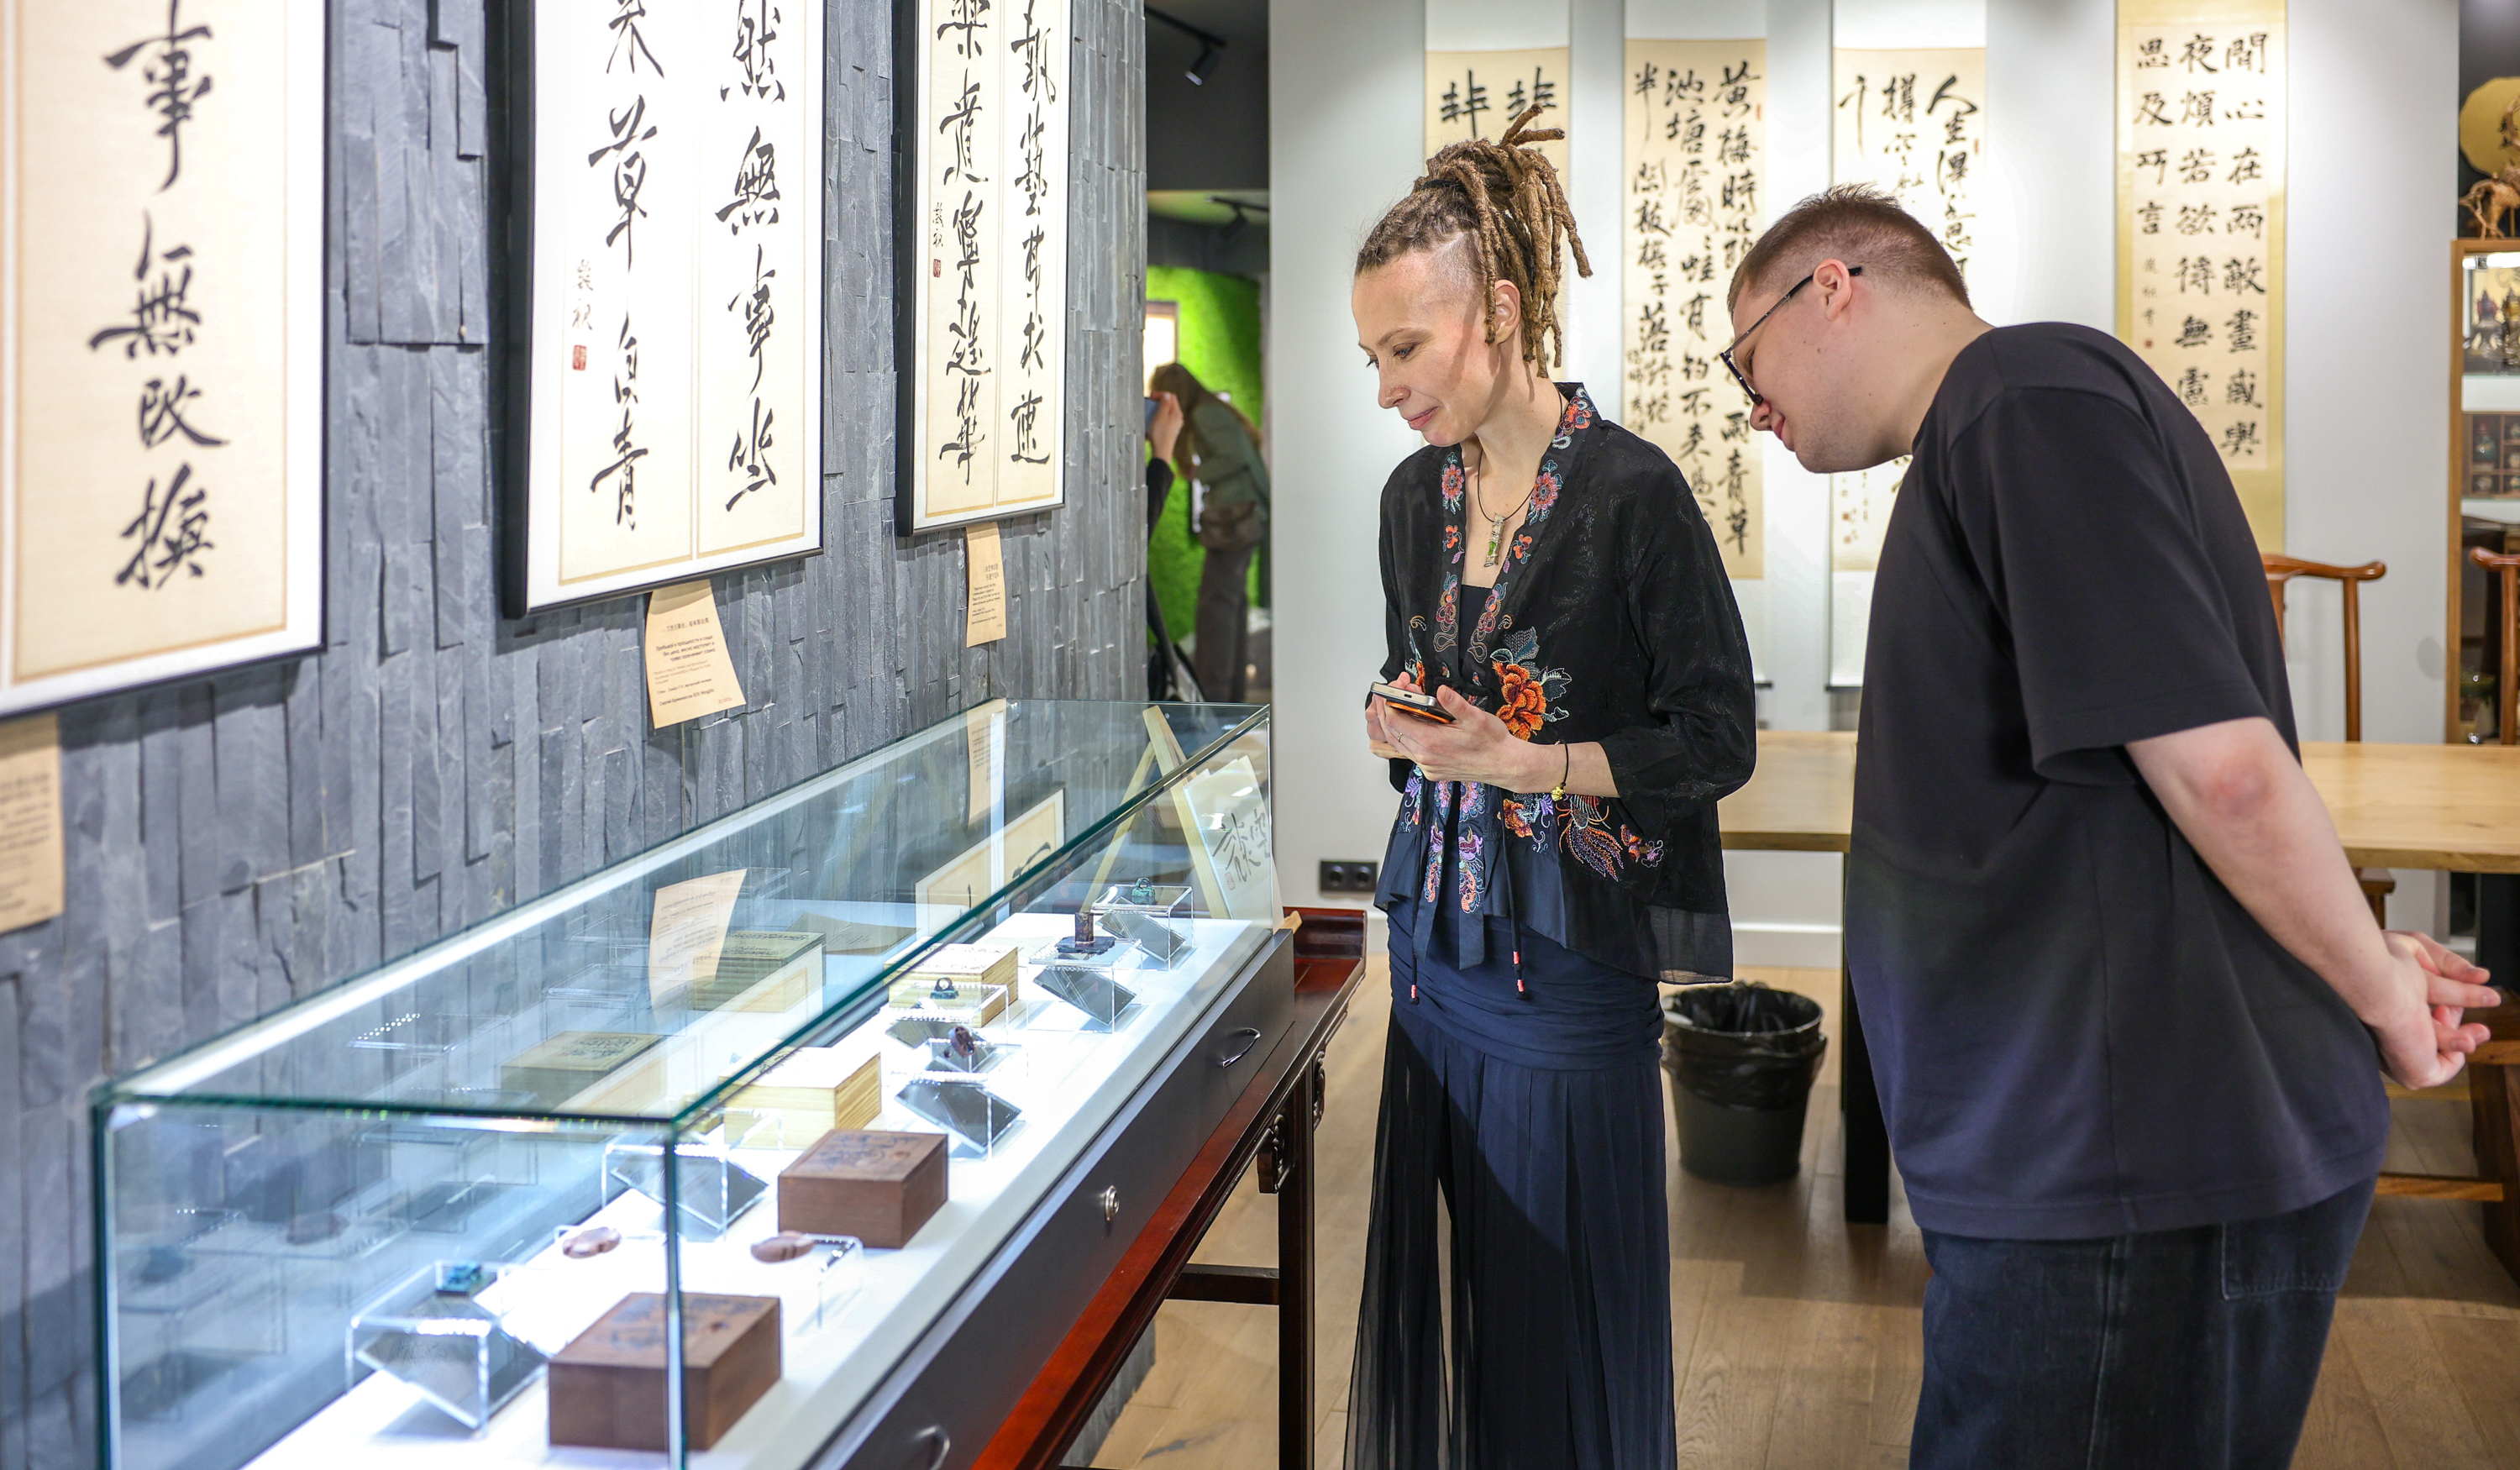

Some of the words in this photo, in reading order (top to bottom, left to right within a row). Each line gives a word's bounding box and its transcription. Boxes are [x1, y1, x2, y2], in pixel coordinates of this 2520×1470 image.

[2173, 34, 2219, 433] 夜煩若欲得無慮
